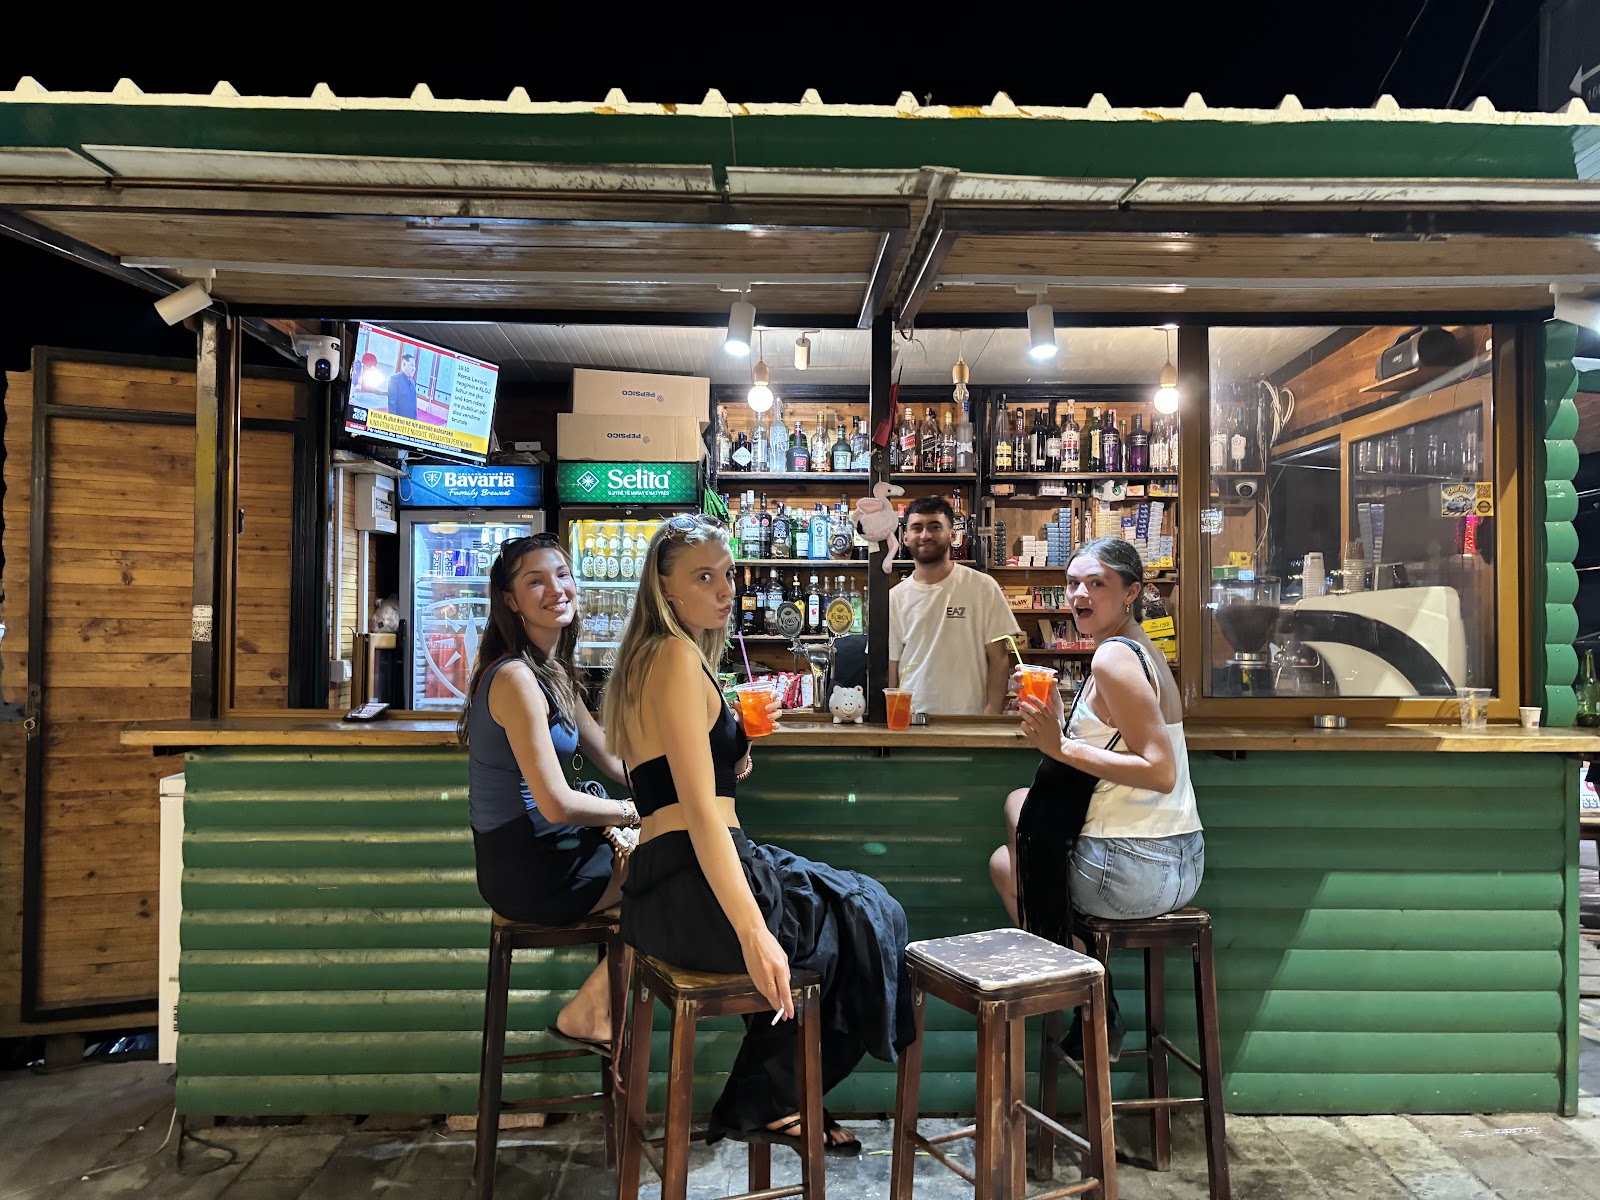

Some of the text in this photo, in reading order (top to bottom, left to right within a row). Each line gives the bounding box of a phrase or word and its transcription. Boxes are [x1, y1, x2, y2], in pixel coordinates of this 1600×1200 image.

[444, 472, 514, 487] Bavaria
[608, 469, 669, 489] Selita
[448, 488, 478, 498] Family
[947, 607, 965, 616] EA7
